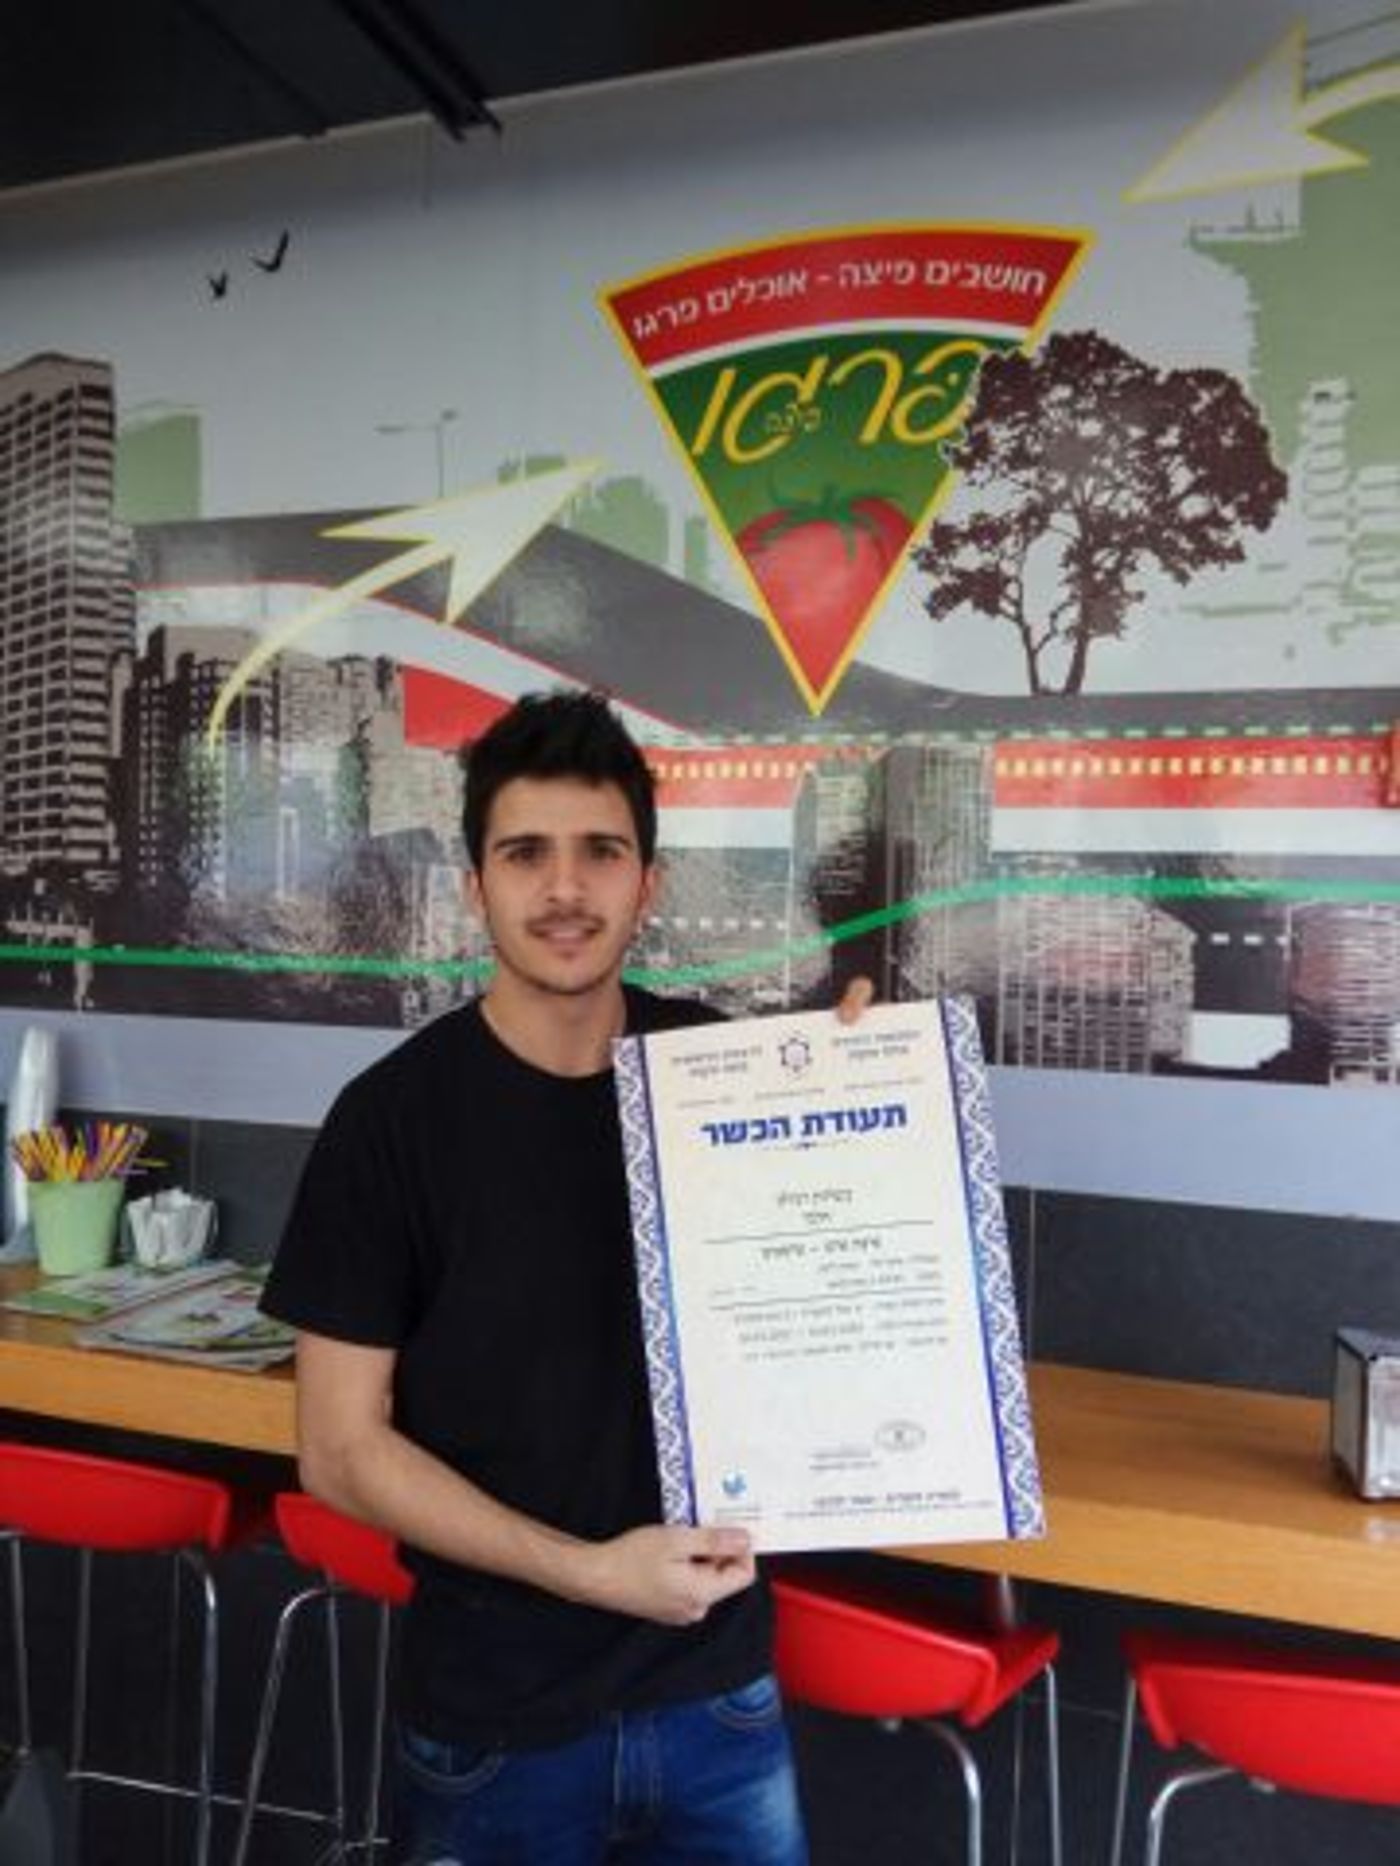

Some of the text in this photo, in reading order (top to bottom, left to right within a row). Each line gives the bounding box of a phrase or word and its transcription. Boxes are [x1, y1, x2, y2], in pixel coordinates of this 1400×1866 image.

[707, 268, 808, 314] אוכלים
[839, 259, 916, 290] פיצה
[924, 262, 1047, 297] חושבים
[632, 298, 700, 340] פרגו
[691, 341, 988, 464] פרגו
[700, 1101, 908, 1148] תעודת הכשר
